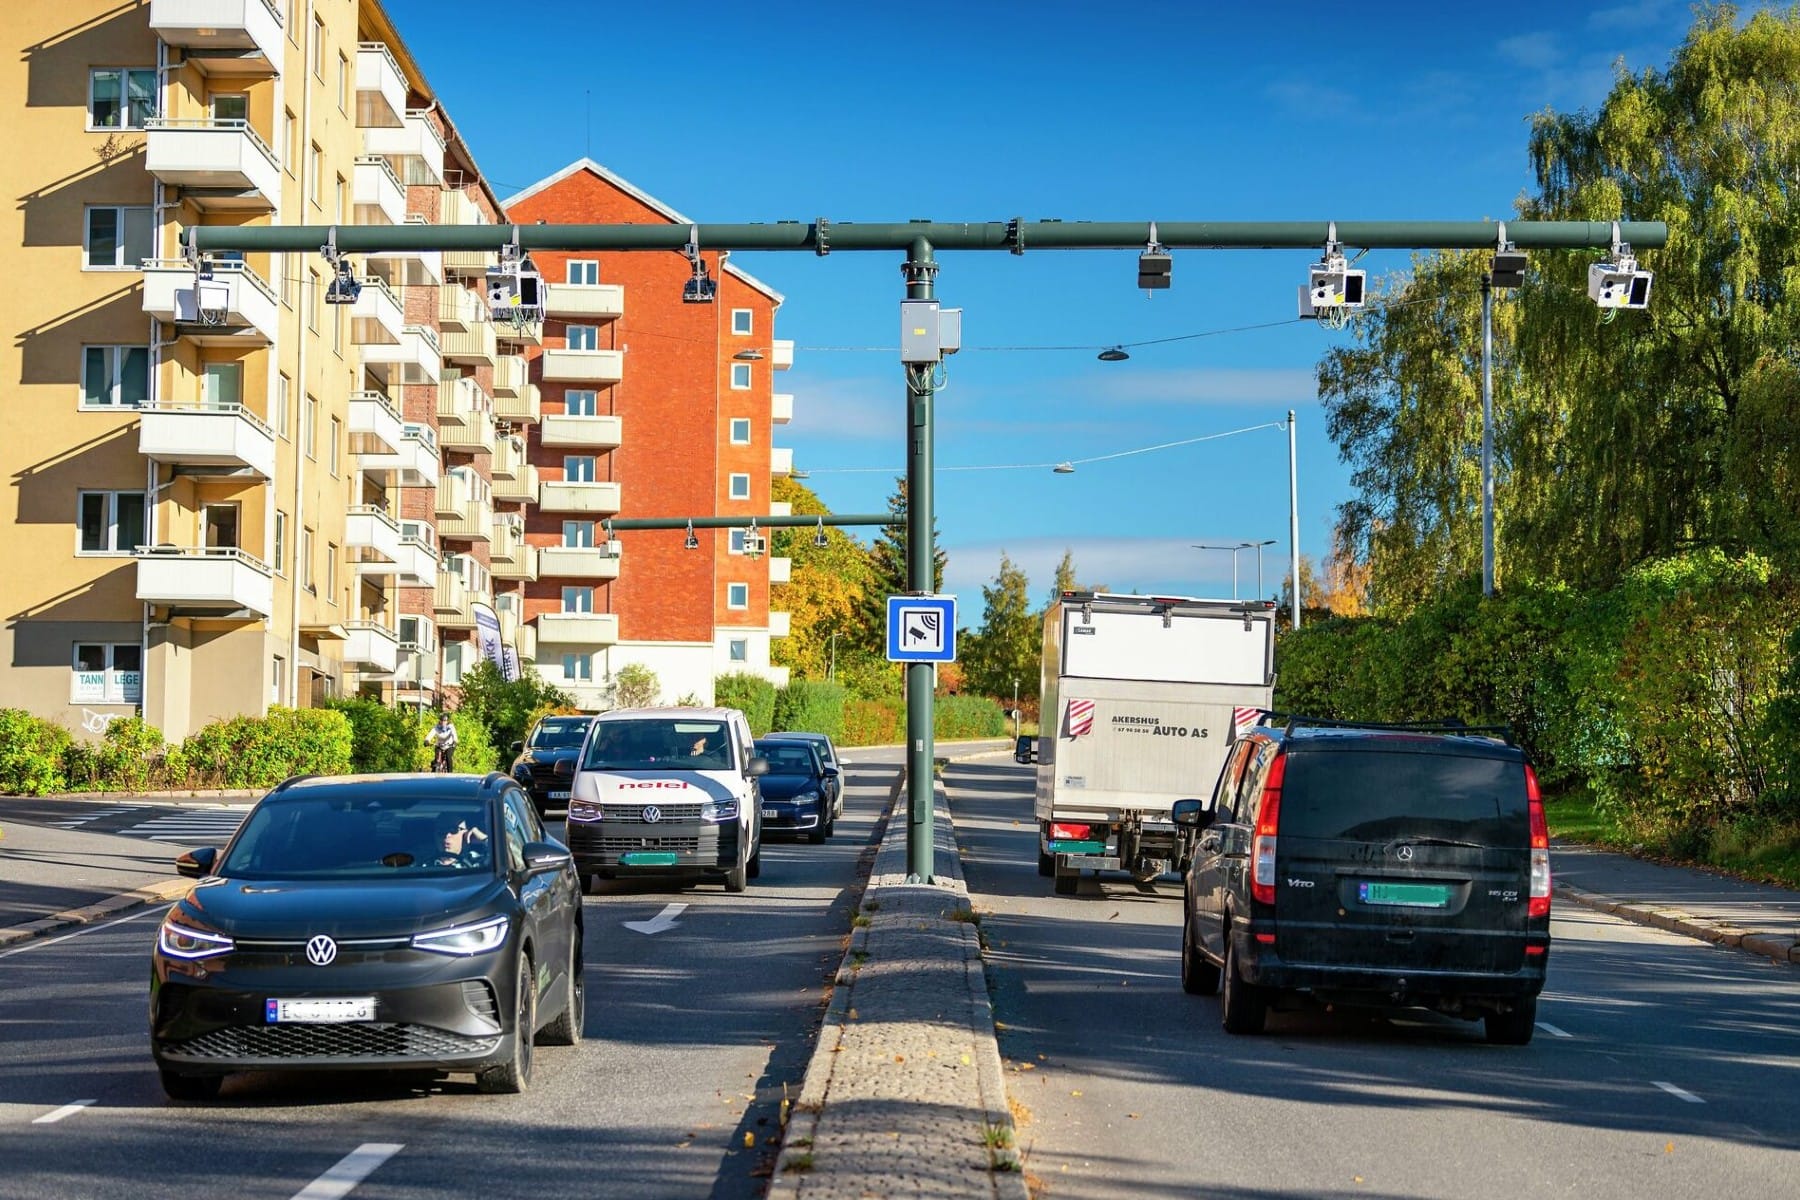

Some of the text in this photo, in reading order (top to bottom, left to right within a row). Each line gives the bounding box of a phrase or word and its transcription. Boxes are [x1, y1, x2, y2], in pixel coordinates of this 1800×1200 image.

[80, 674, 139, 685] TANN LEGE
[1111, 716, 1160, 725] AKERSHUS
[1153, 726, 1208, 738] AUTO AS
